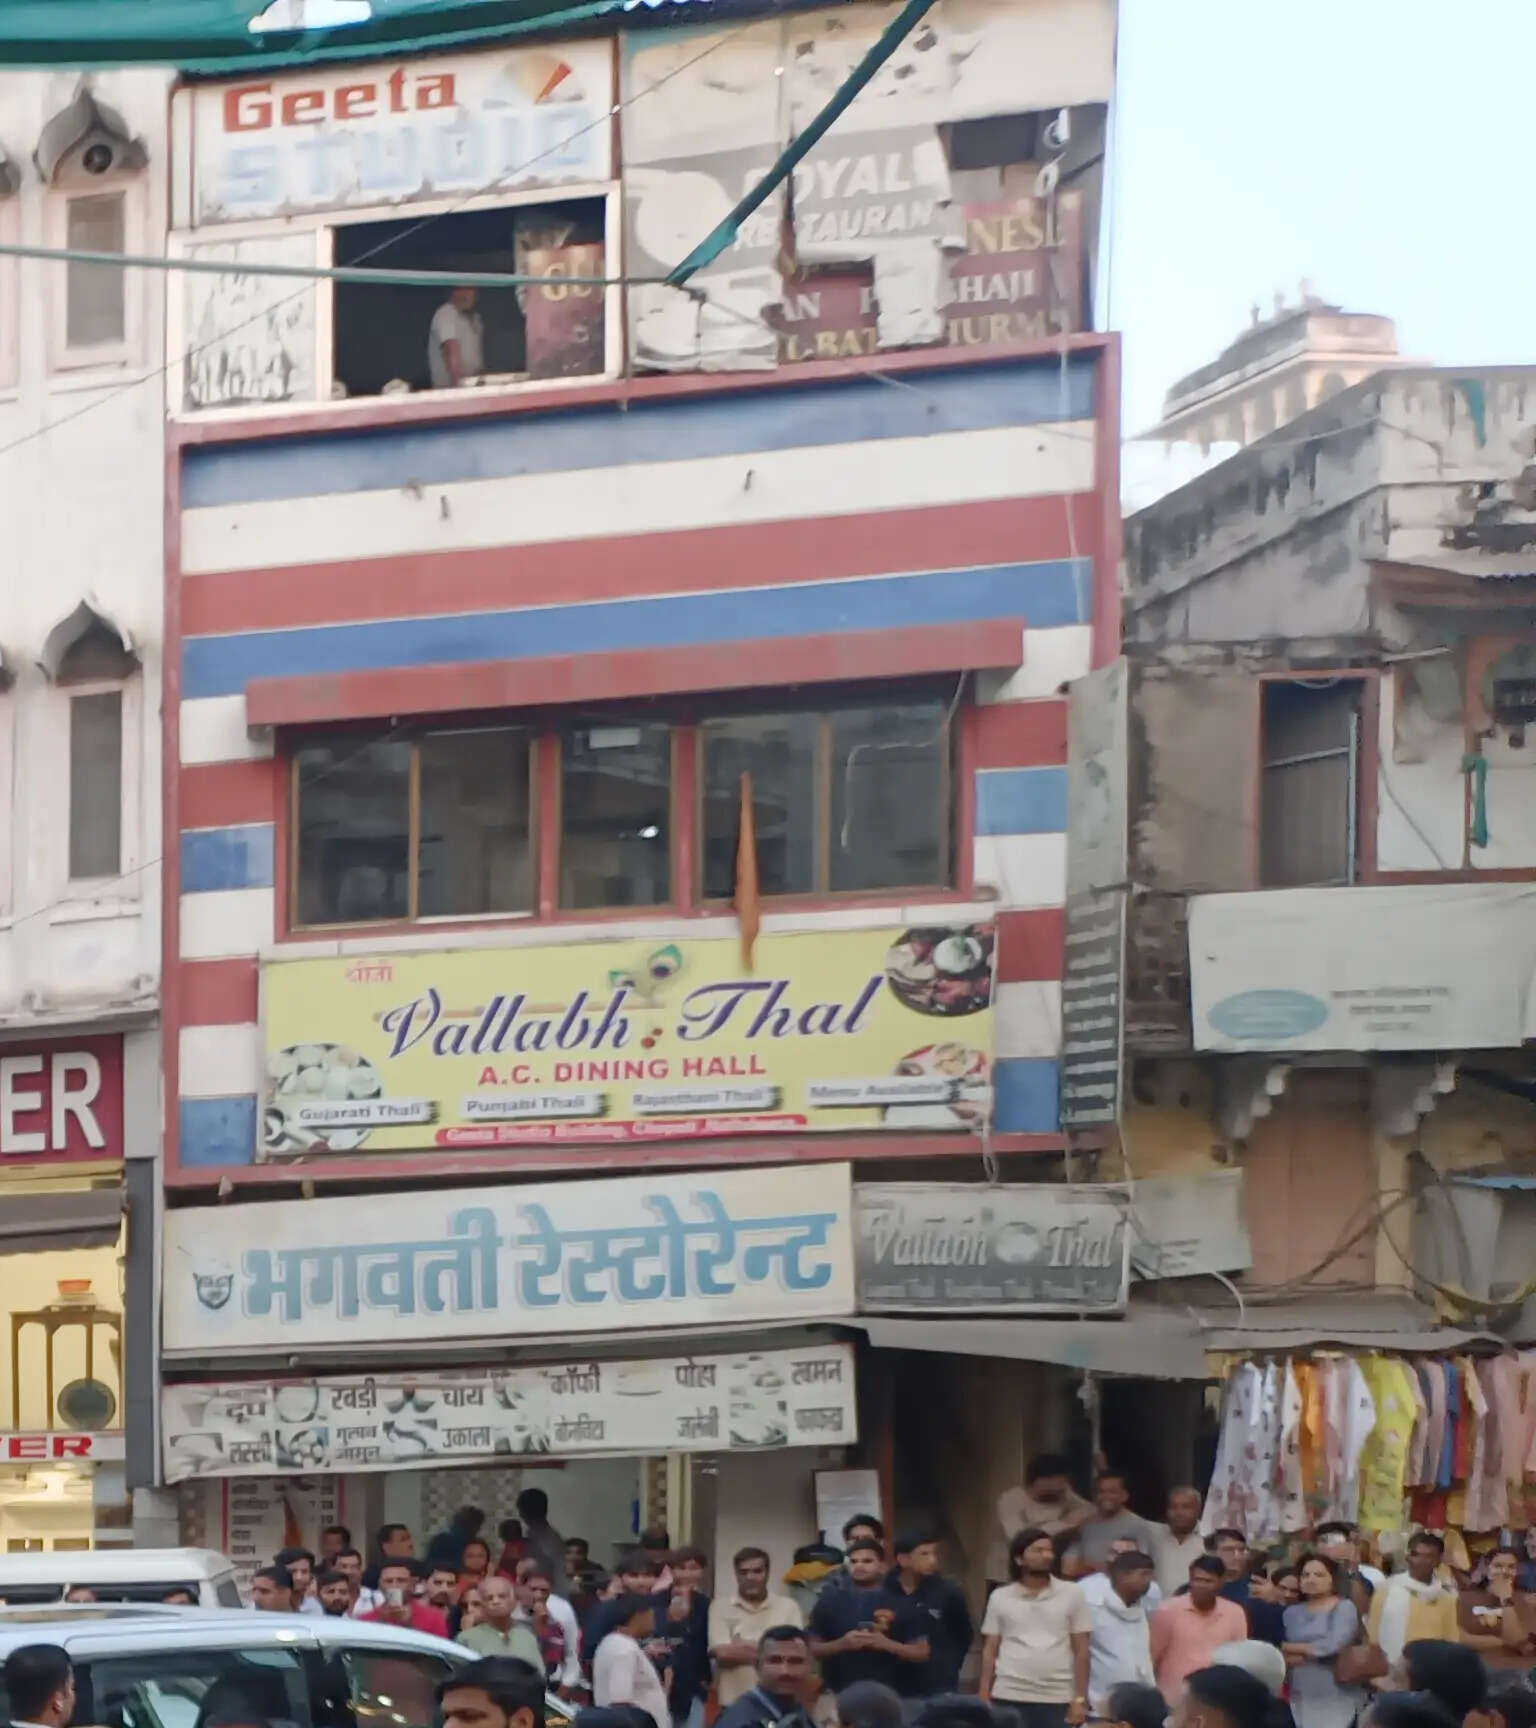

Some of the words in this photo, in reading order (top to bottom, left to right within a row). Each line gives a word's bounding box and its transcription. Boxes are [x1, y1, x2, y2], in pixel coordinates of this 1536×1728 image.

[224, 66, 456, 133] Geeta
[225, 107, 593, 204] STUDIO
[381, 987, 633, 1059] Vallabh
[676, 974, 885, 1040] Thal
[477, 1065, 541, 1086] A.C.
[553, 1056, 670, 1083] DINING
[682, 1053, 767, 1077] HALL
[299, 1107, 372, 1123] Gujarati
[377, 1102, 422, 1118] Thali
[466, 1098, 537, 1115] Punjabi
[543, 1095, 586, 1110] Thali
[242, 1208, 502, 1322] भगवती
[512, 1191, 837, 1306] रेस्टोरेन्ट
